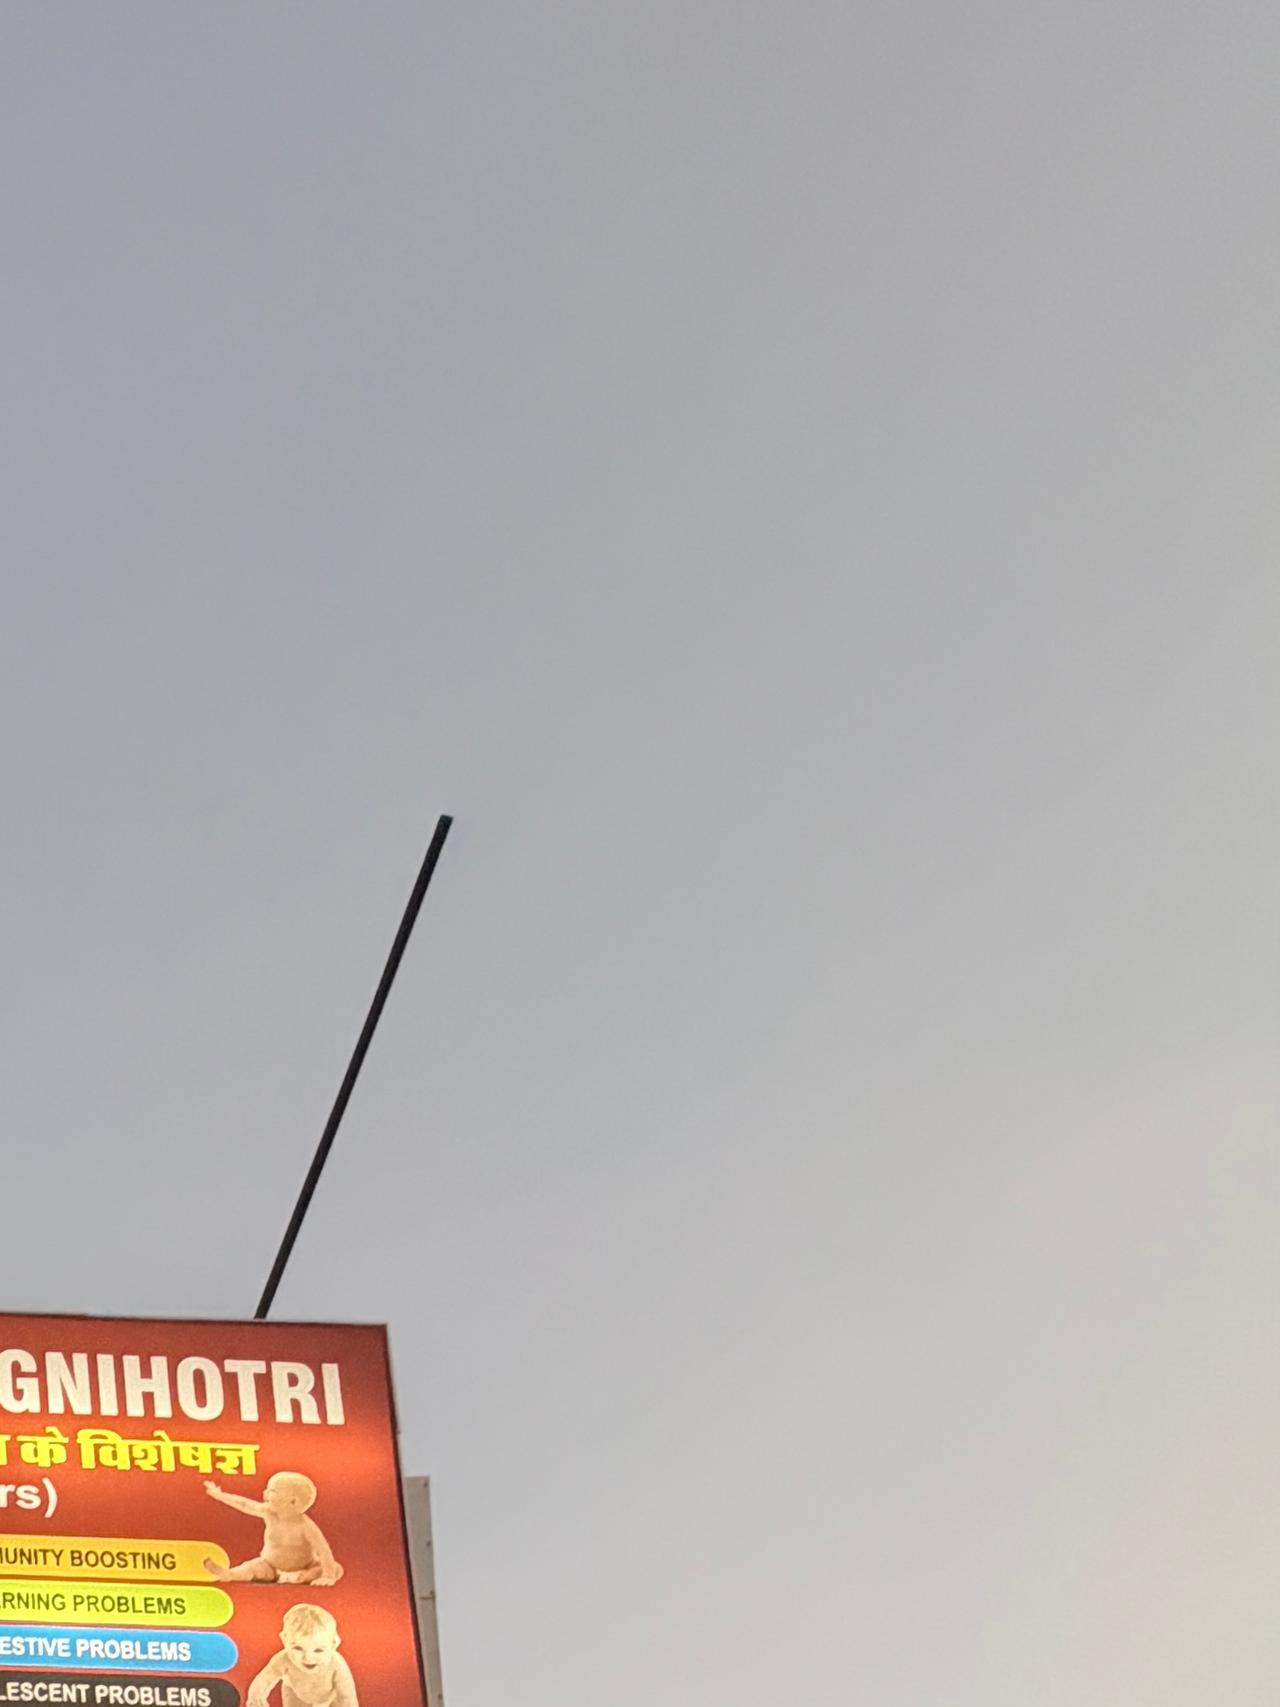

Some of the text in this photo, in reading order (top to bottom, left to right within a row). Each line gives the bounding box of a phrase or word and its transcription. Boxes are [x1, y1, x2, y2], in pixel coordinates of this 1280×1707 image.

[17, 1426, 70, 1468] के
[77, 1428, 260, 1475] विशेषज्ञ
[70, 1549, 177, 1571] BOOSTING
[73, 1594, 186, 1615] PROBLEMS
[76, 1638, 191, 1662] PROBLEMS
[95, 1683, 211, 1707] PROBLEMS
